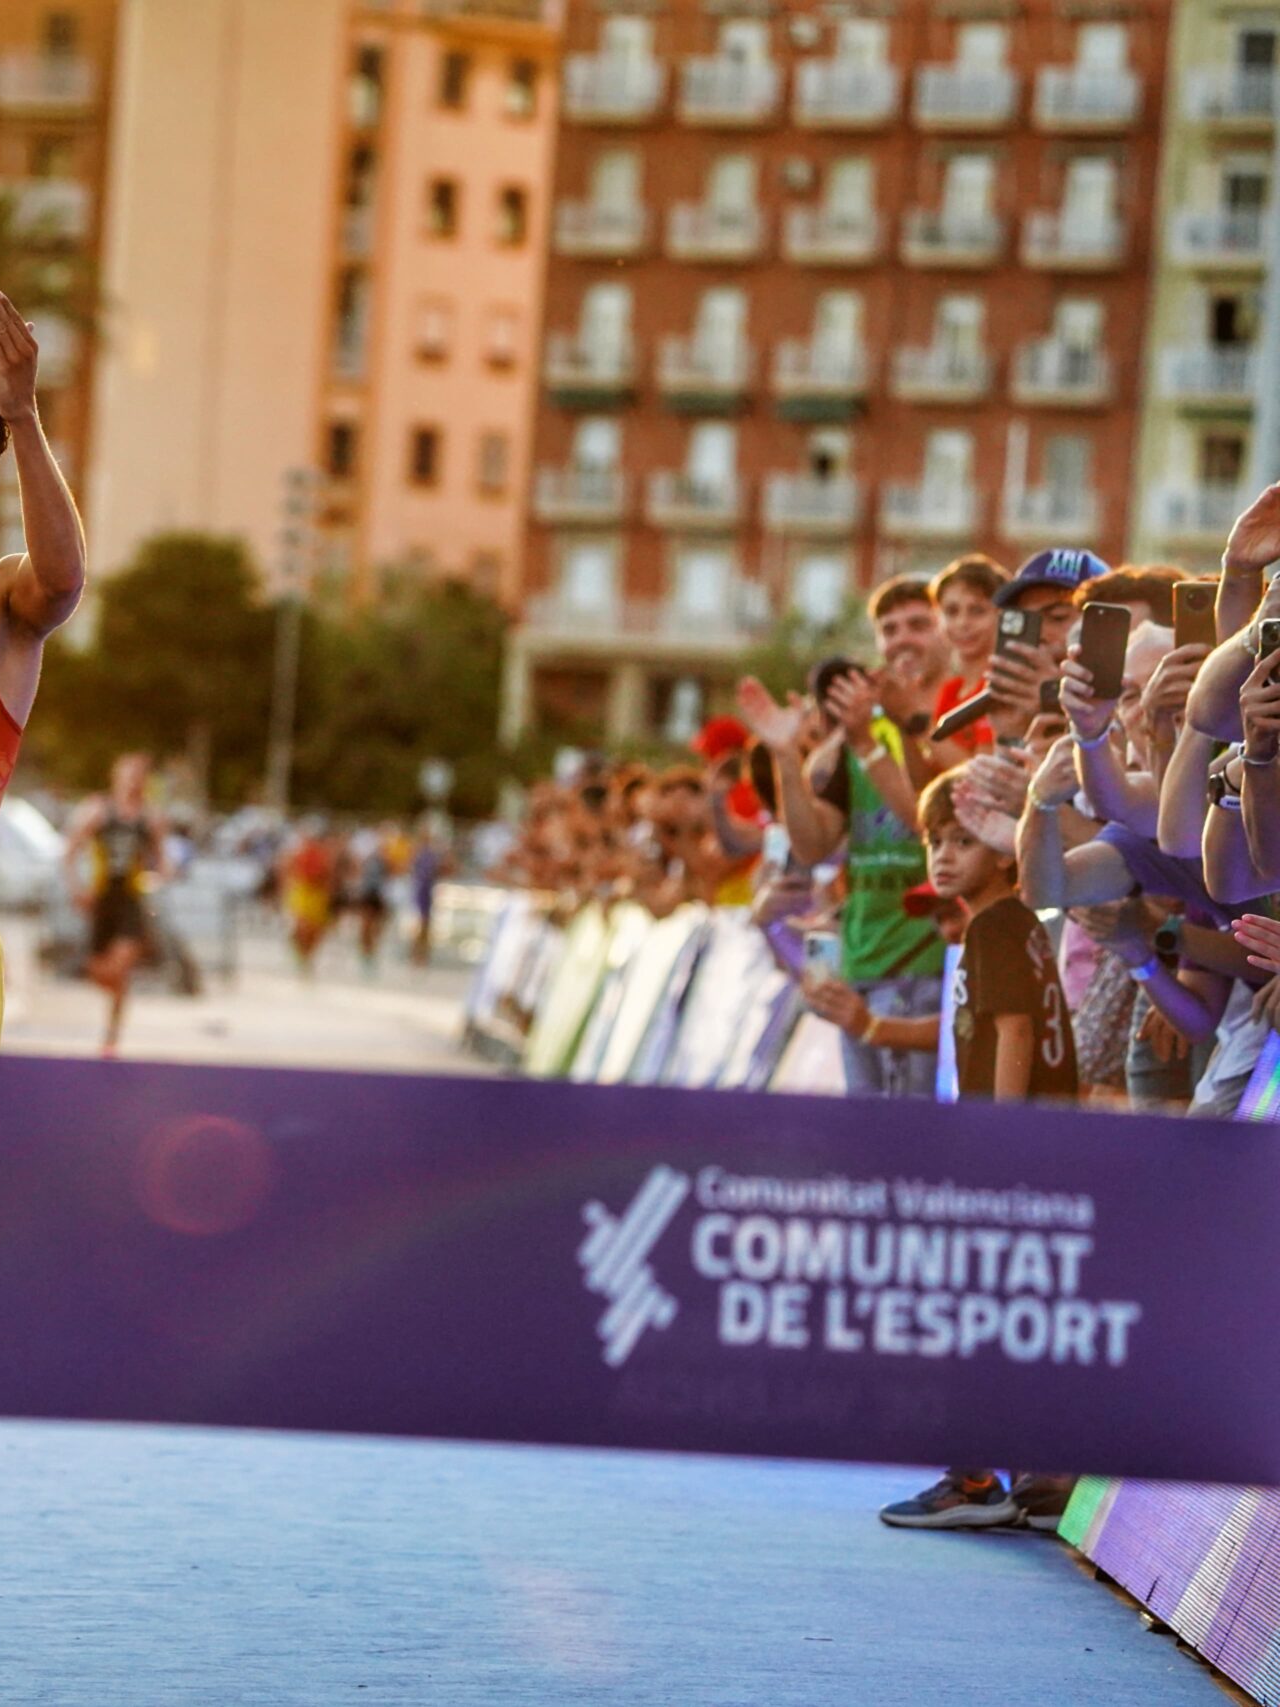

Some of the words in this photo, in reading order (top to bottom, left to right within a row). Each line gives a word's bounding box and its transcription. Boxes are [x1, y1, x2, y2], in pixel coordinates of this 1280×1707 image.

[696, 1166, 887, 1217] Comunitat
[895, 1180, 1096, 1228] Valenciana
[691, 1214, 1094, 1297] COMUNITAT
[719, 1283, 812, 1348] DE
[825, 1288, 1142, 1367] L'ESPORT
